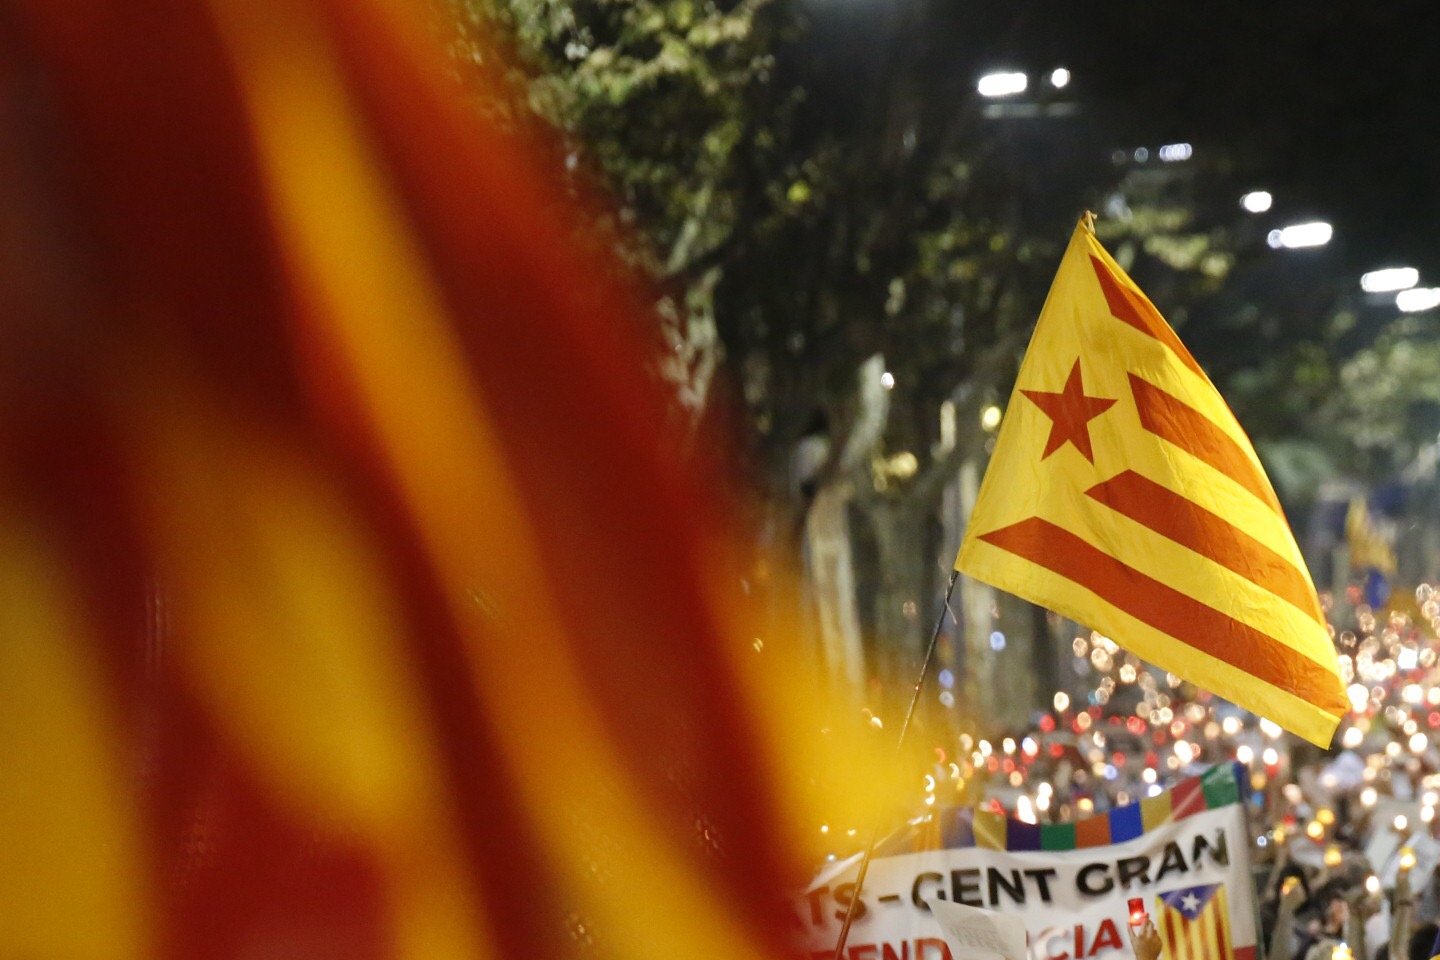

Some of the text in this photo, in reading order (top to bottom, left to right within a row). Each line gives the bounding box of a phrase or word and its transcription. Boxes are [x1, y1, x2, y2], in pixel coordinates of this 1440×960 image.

[806, 884, 866, 926] TS
[911, 867, 1057, 911] GENT
[1075, 826, 1230, 897] GRAN
